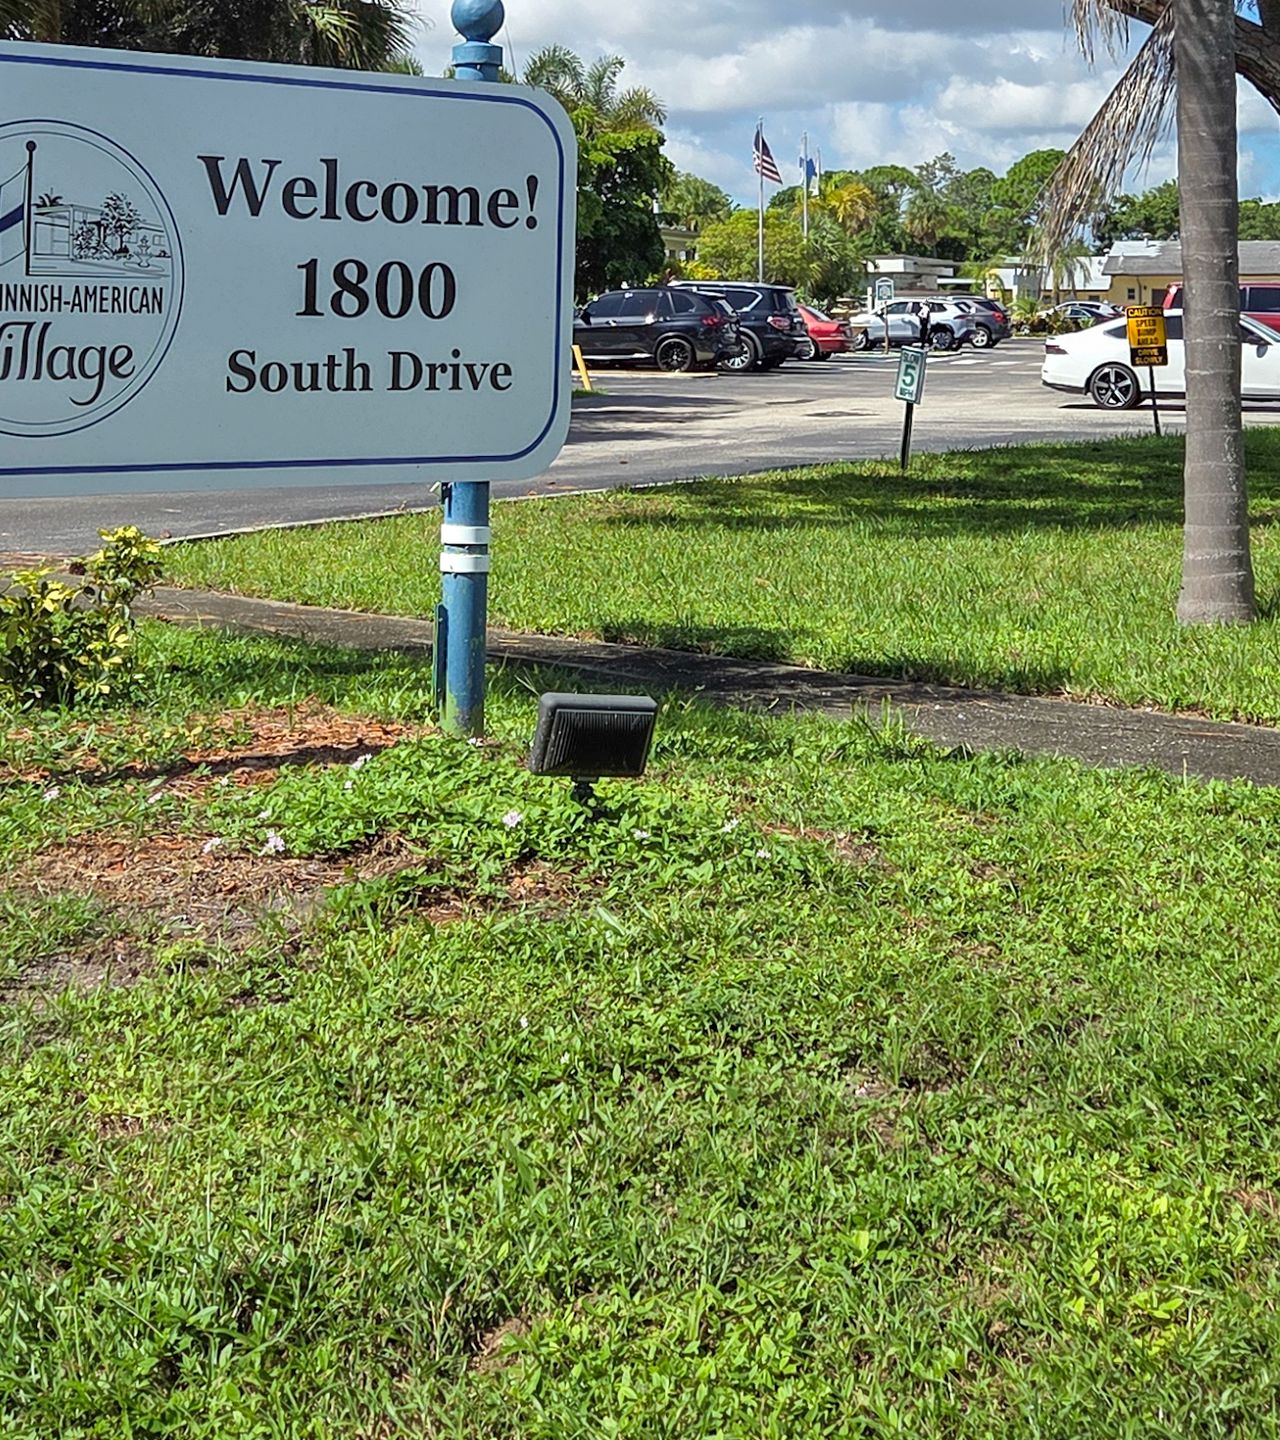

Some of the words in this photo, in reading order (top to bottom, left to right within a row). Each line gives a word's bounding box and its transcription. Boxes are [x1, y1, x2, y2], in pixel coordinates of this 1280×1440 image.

[197, 155, 539, 230] Welcome!
[295, 258, 456, 320] 1800
[1128, 308, 1162, 317] CAUTION
[1135, 319, 1156, 327] SPEED
[226, 347, 373, 393] South
[386, 348, 513, 392] Drive
[1135, 356, 1163, 364] SLOWLY
[902, 364, 916, 387] 5
